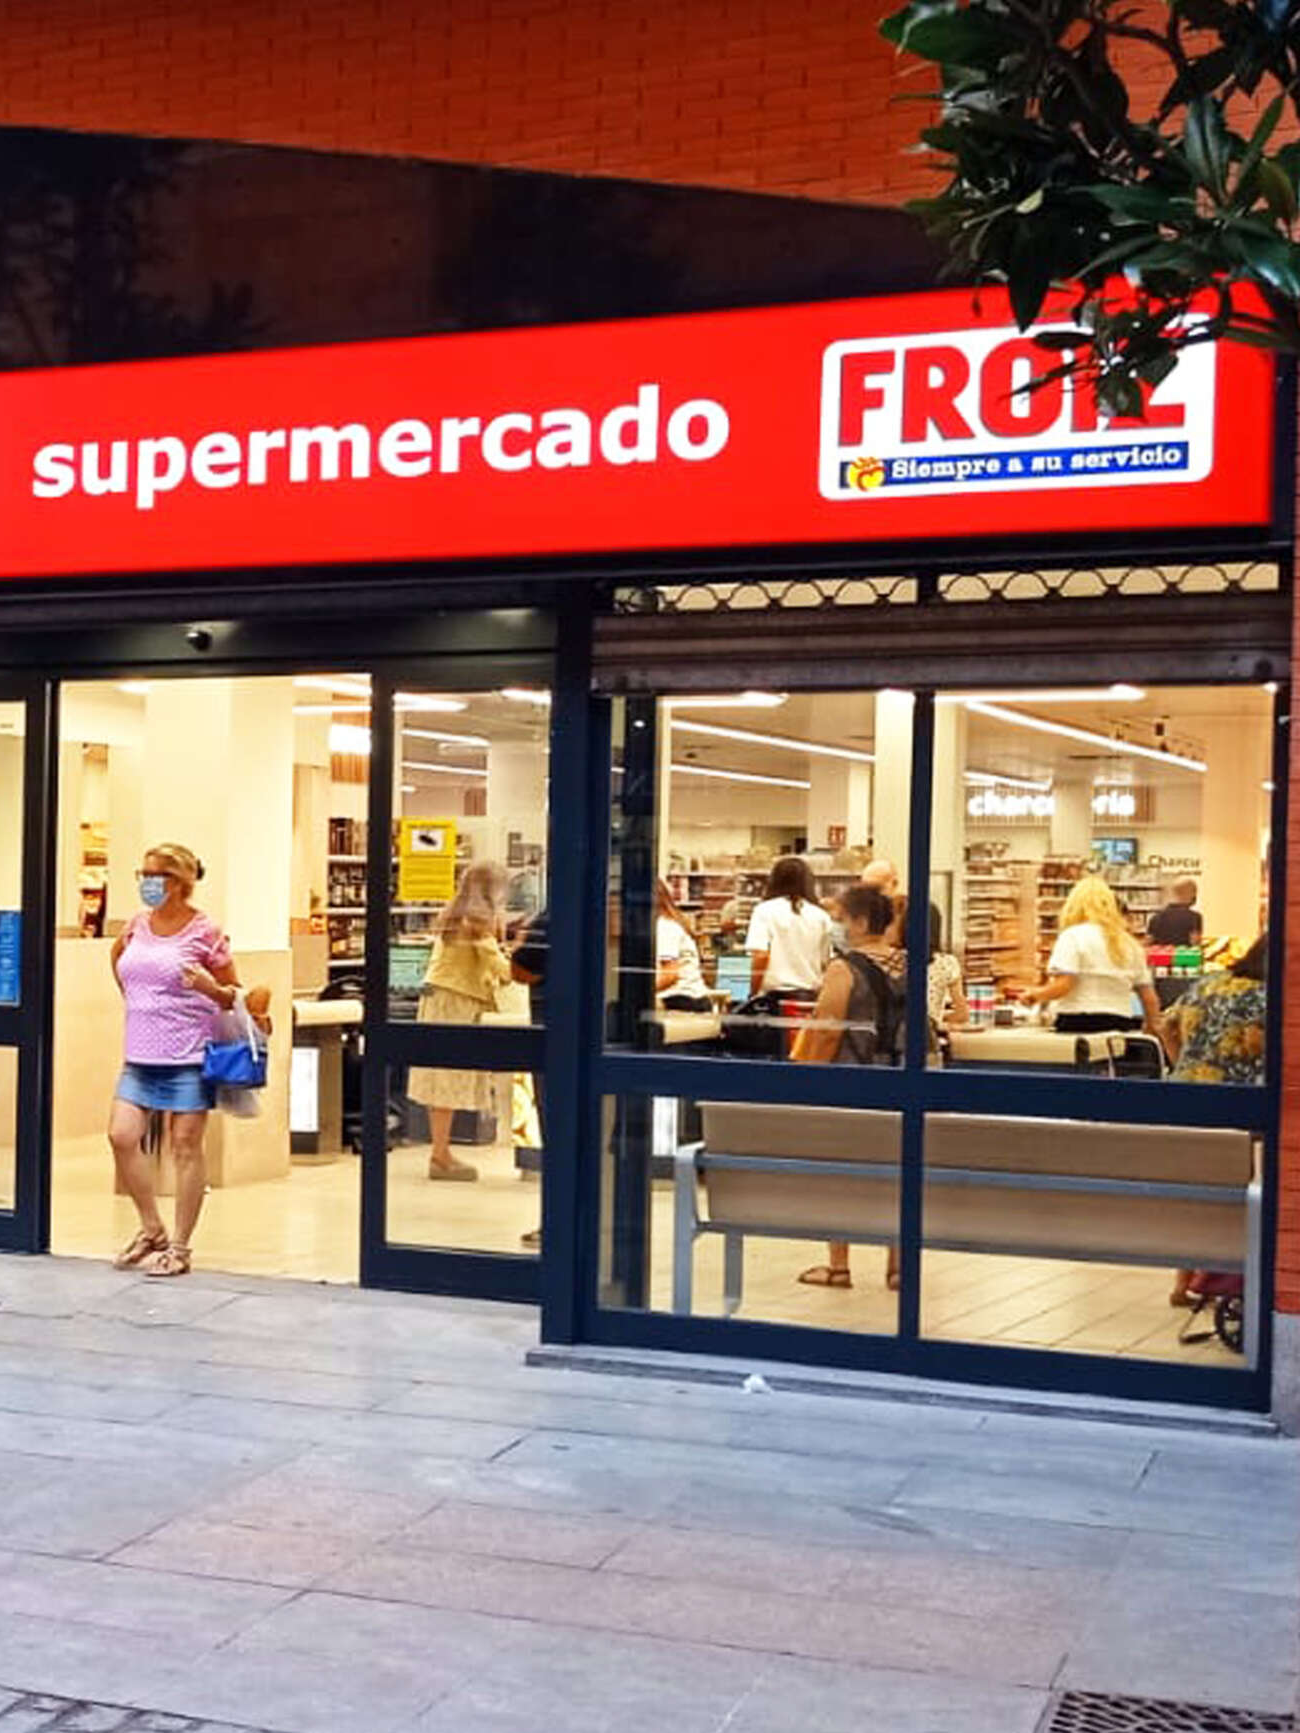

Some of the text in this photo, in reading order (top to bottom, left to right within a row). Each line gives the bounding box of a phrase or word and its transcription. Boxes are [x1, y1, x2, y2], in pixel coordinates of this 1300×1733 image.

[32, 384, 730, 510] supermercado
[891, 446, 1180, 480] Siempre a su servicio
